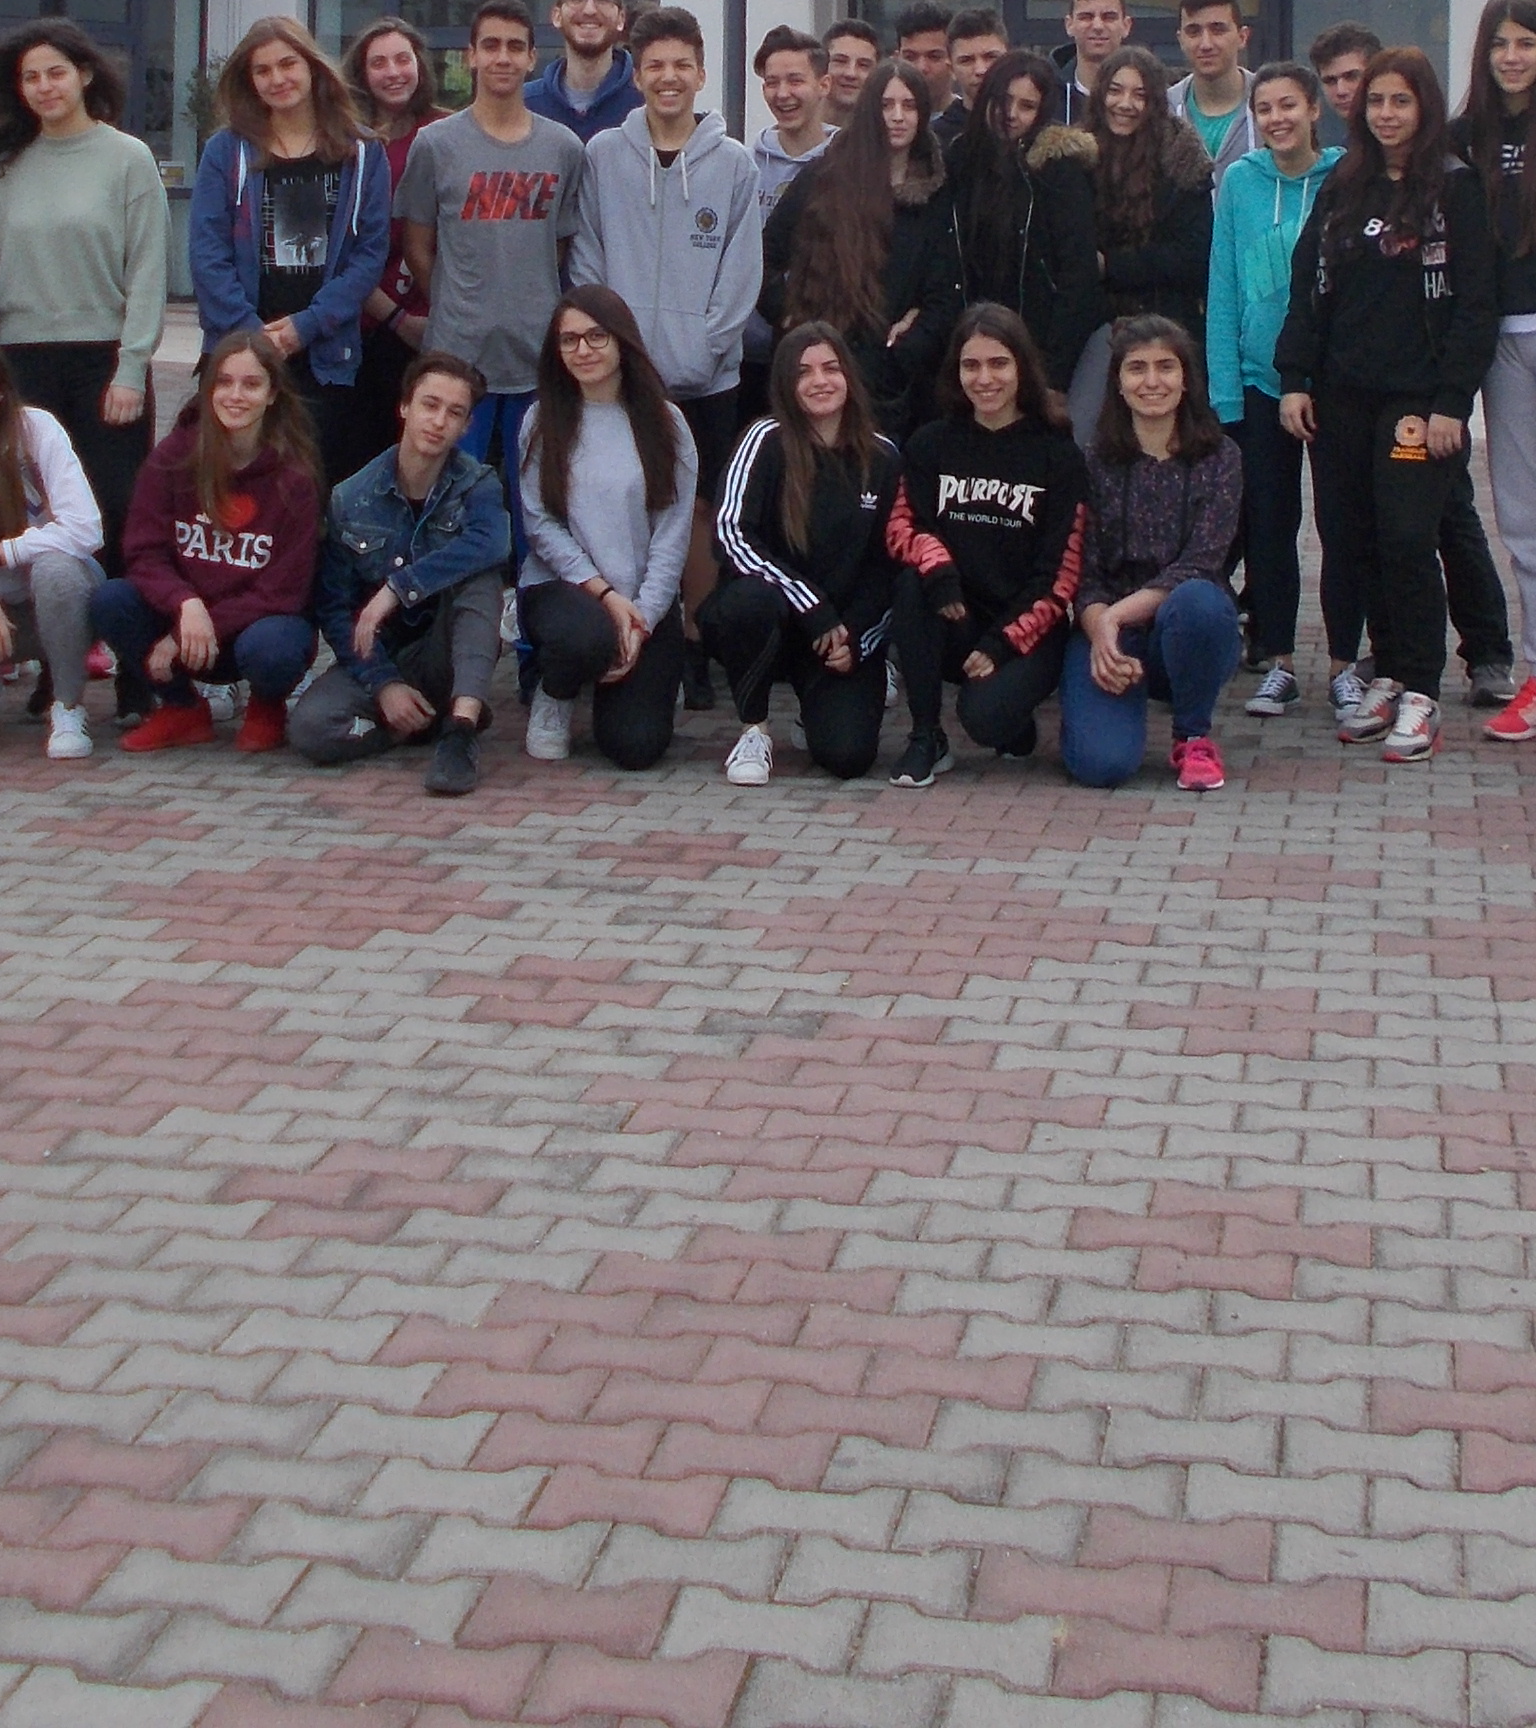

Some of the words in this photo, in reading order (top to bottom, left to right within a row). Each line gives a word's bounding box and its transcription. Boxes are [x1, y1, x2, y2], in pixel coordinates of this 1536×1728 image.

[460, 171, 560, 220] NIKE
[937, 474, 1046, 526] PURPOSE
[949, 511, 965, 521] THE
[967, 513, 998, 524] WORLD
[175, 520, 273, 569] PARIS
